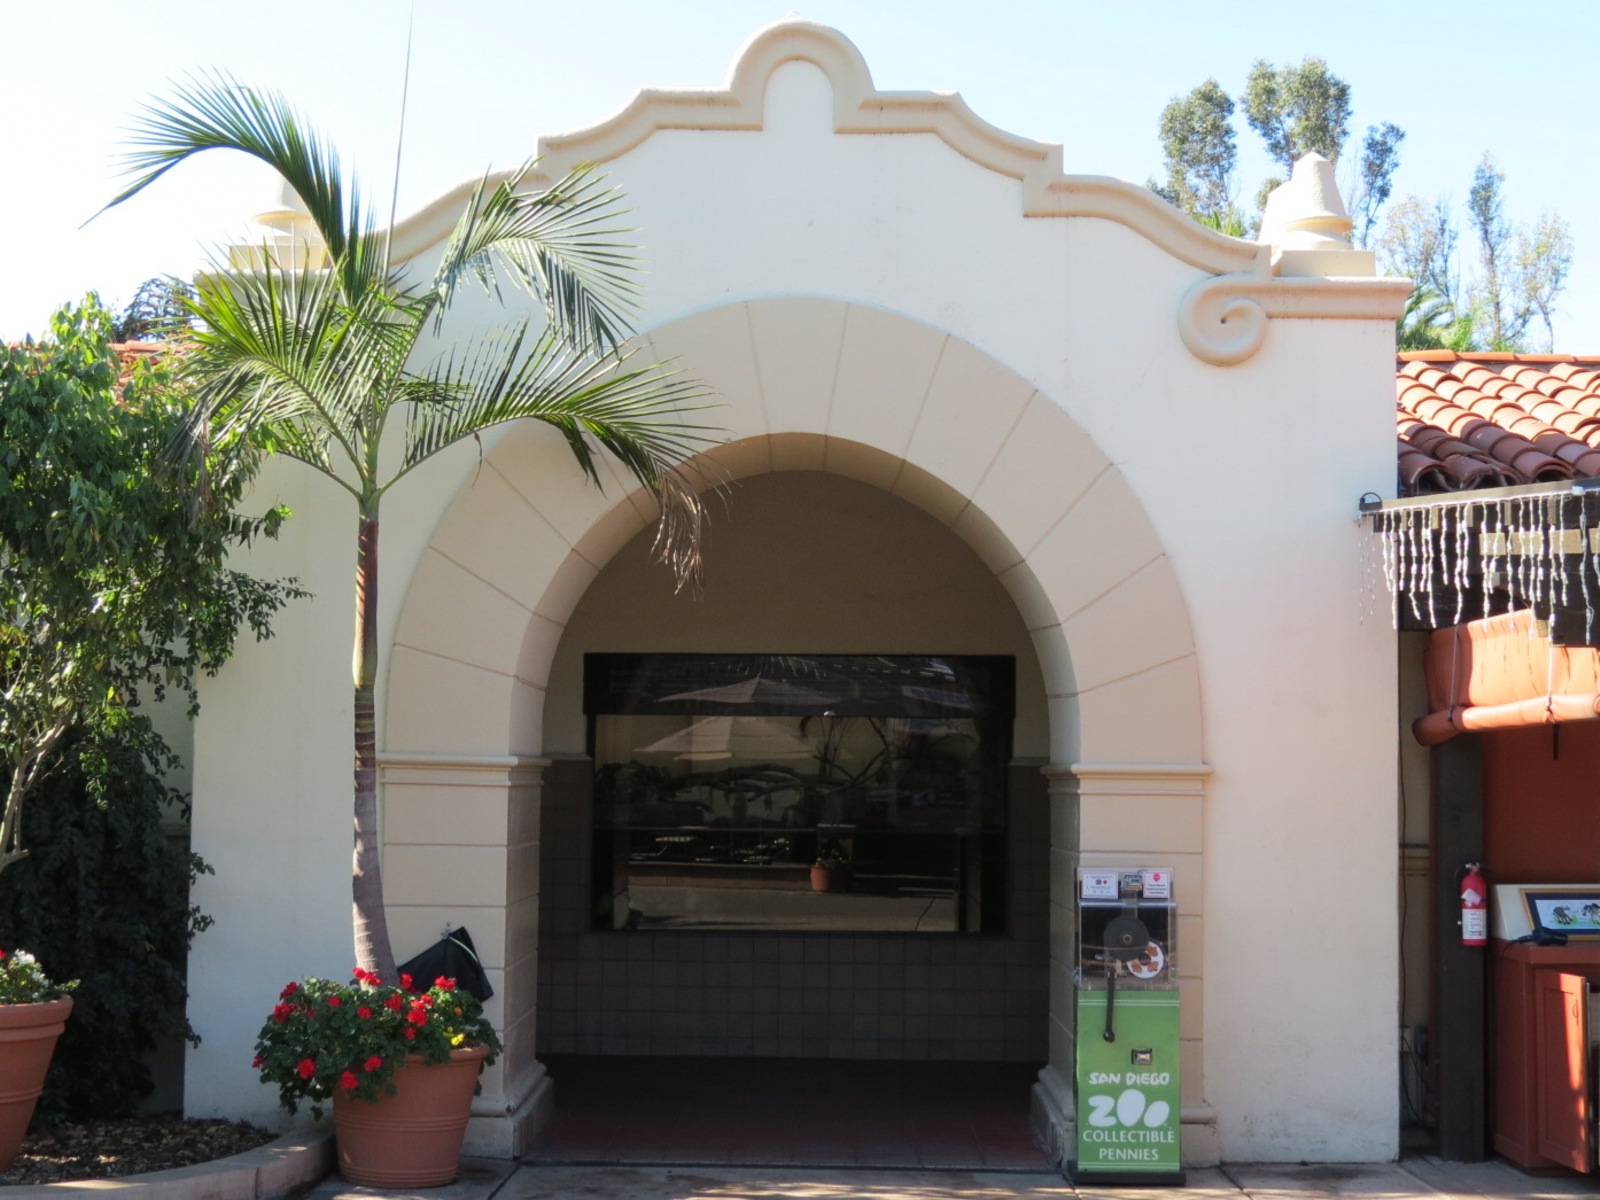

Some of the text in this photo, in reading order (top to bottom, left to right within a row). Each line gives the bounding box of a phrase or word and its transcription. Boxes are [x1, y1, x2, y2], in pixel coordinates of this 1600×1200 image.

[1088, 1072, 1170, 1086] SAN DIEGO
[1087, 1088, 1170, 1128] ZOO
[1083, 1130, 1175, 1143] COLLECTIBLE
[1099, 1148, 1159, 1161] PENNIES
